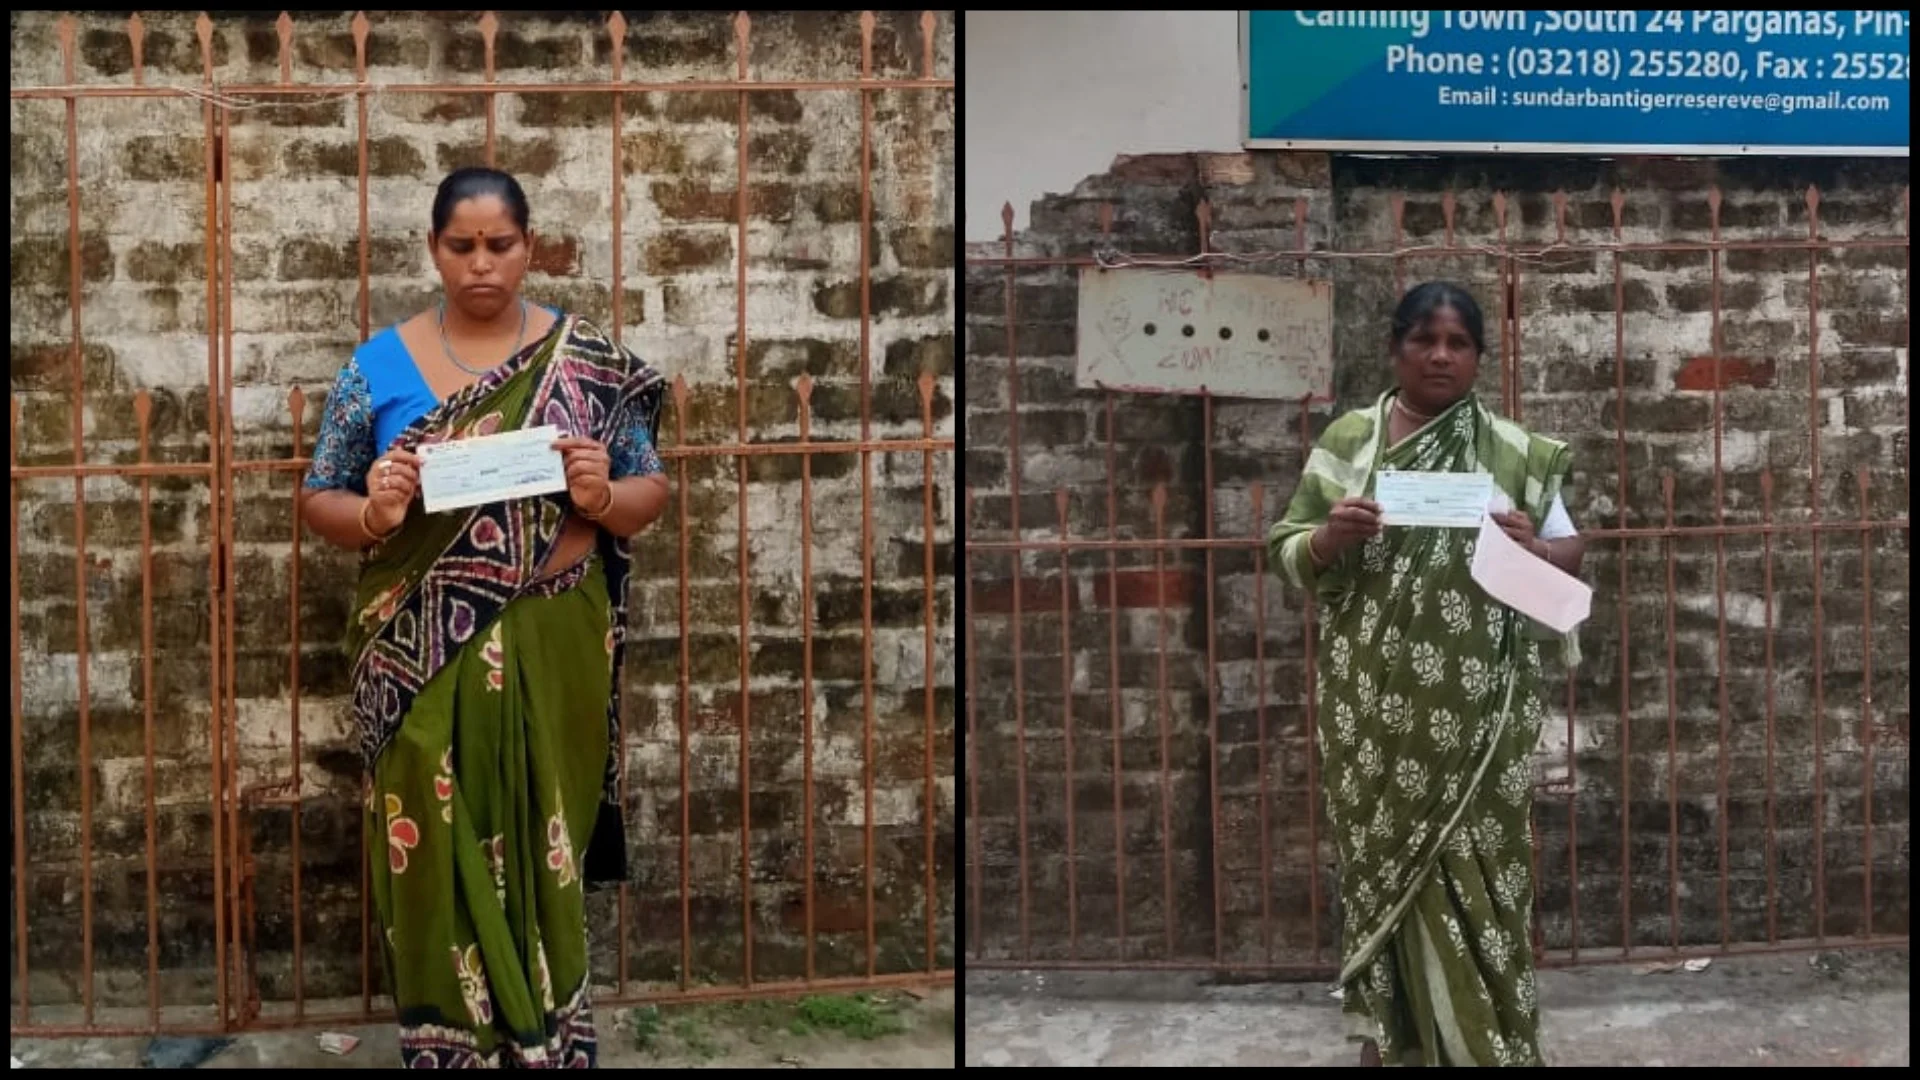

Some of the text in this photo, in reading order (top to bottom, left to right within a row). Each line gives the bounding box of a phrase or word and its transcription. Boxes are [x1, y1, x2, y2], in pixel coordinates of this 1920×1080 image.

[1295, 10, 1429, 37] Canning
[1645, 10, 1684, 33] 24
[1692, 10, 1846, 42] Parganas,
[1386, 44, 1910, 82] Phone : (03218) 255280, Fax : 2552
[1438, 85, 1890, 114] Email : sundarbantigerresereve@gmail.com
